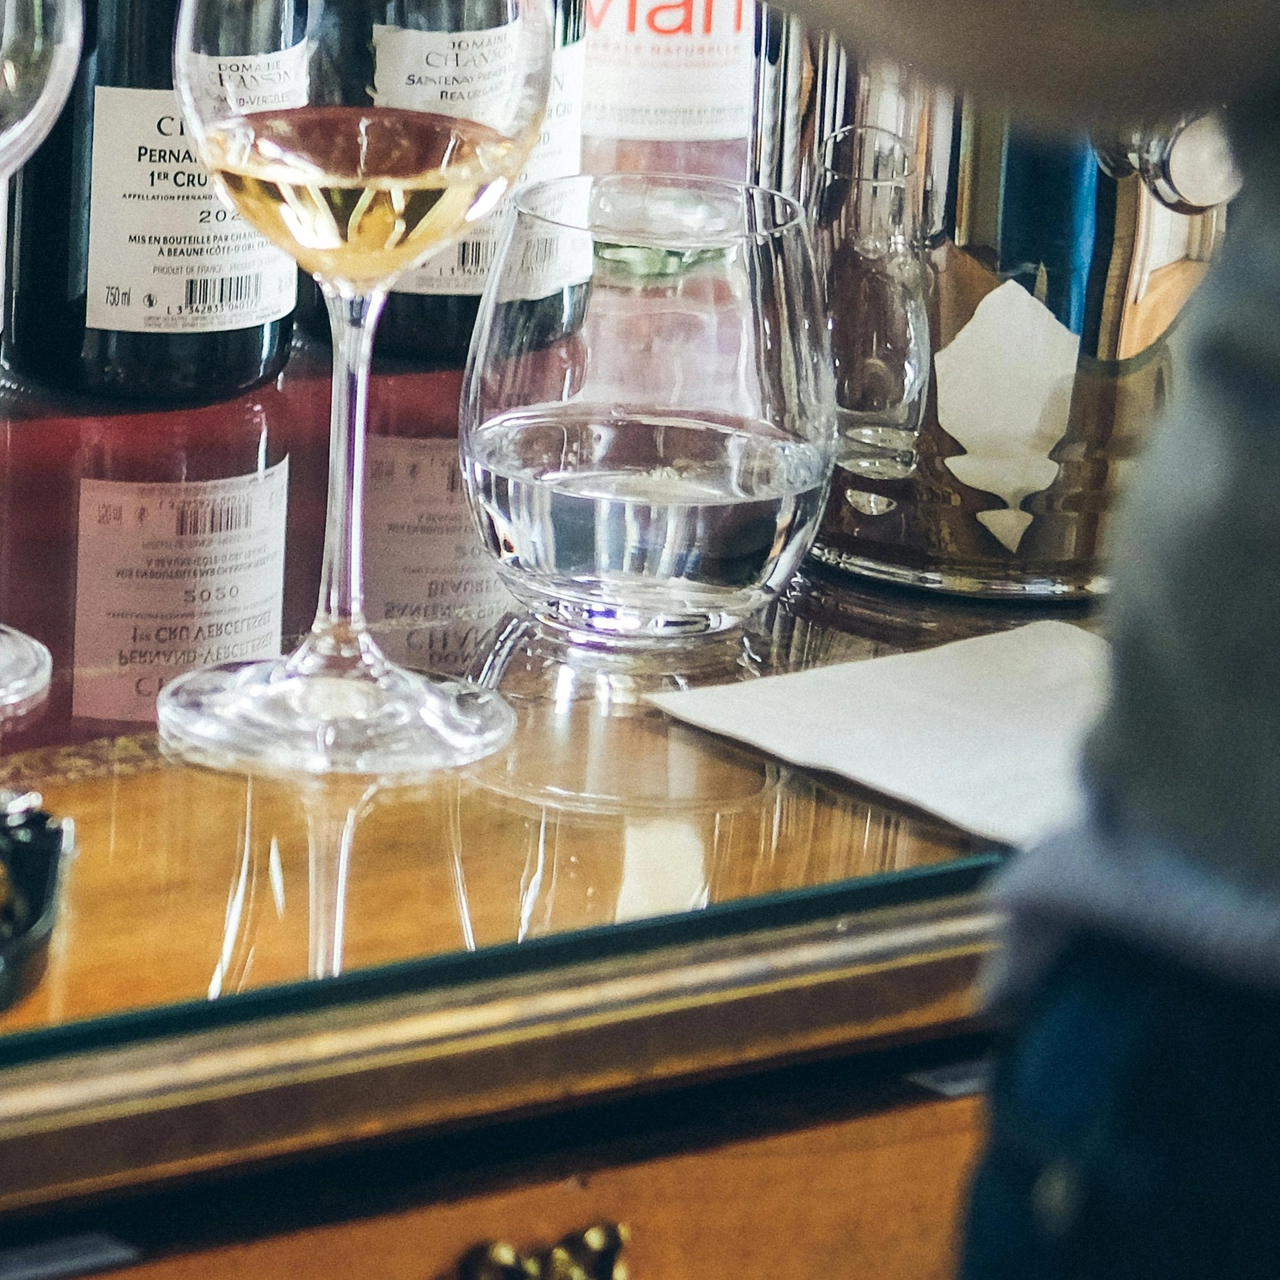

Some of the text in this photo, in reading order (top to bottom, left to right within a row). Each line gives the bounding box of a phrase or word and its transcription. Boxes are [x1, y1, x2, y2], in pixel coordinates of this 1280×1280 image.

[173, 170, 208, 187] CRU
[128, 234, 229, 246] MIS EN BOUTEILLE PAR
[167, 246, 205, 258] BEAUNE
[104, 286, 121, 306] 750
[176, 306, 183, 315] 3
